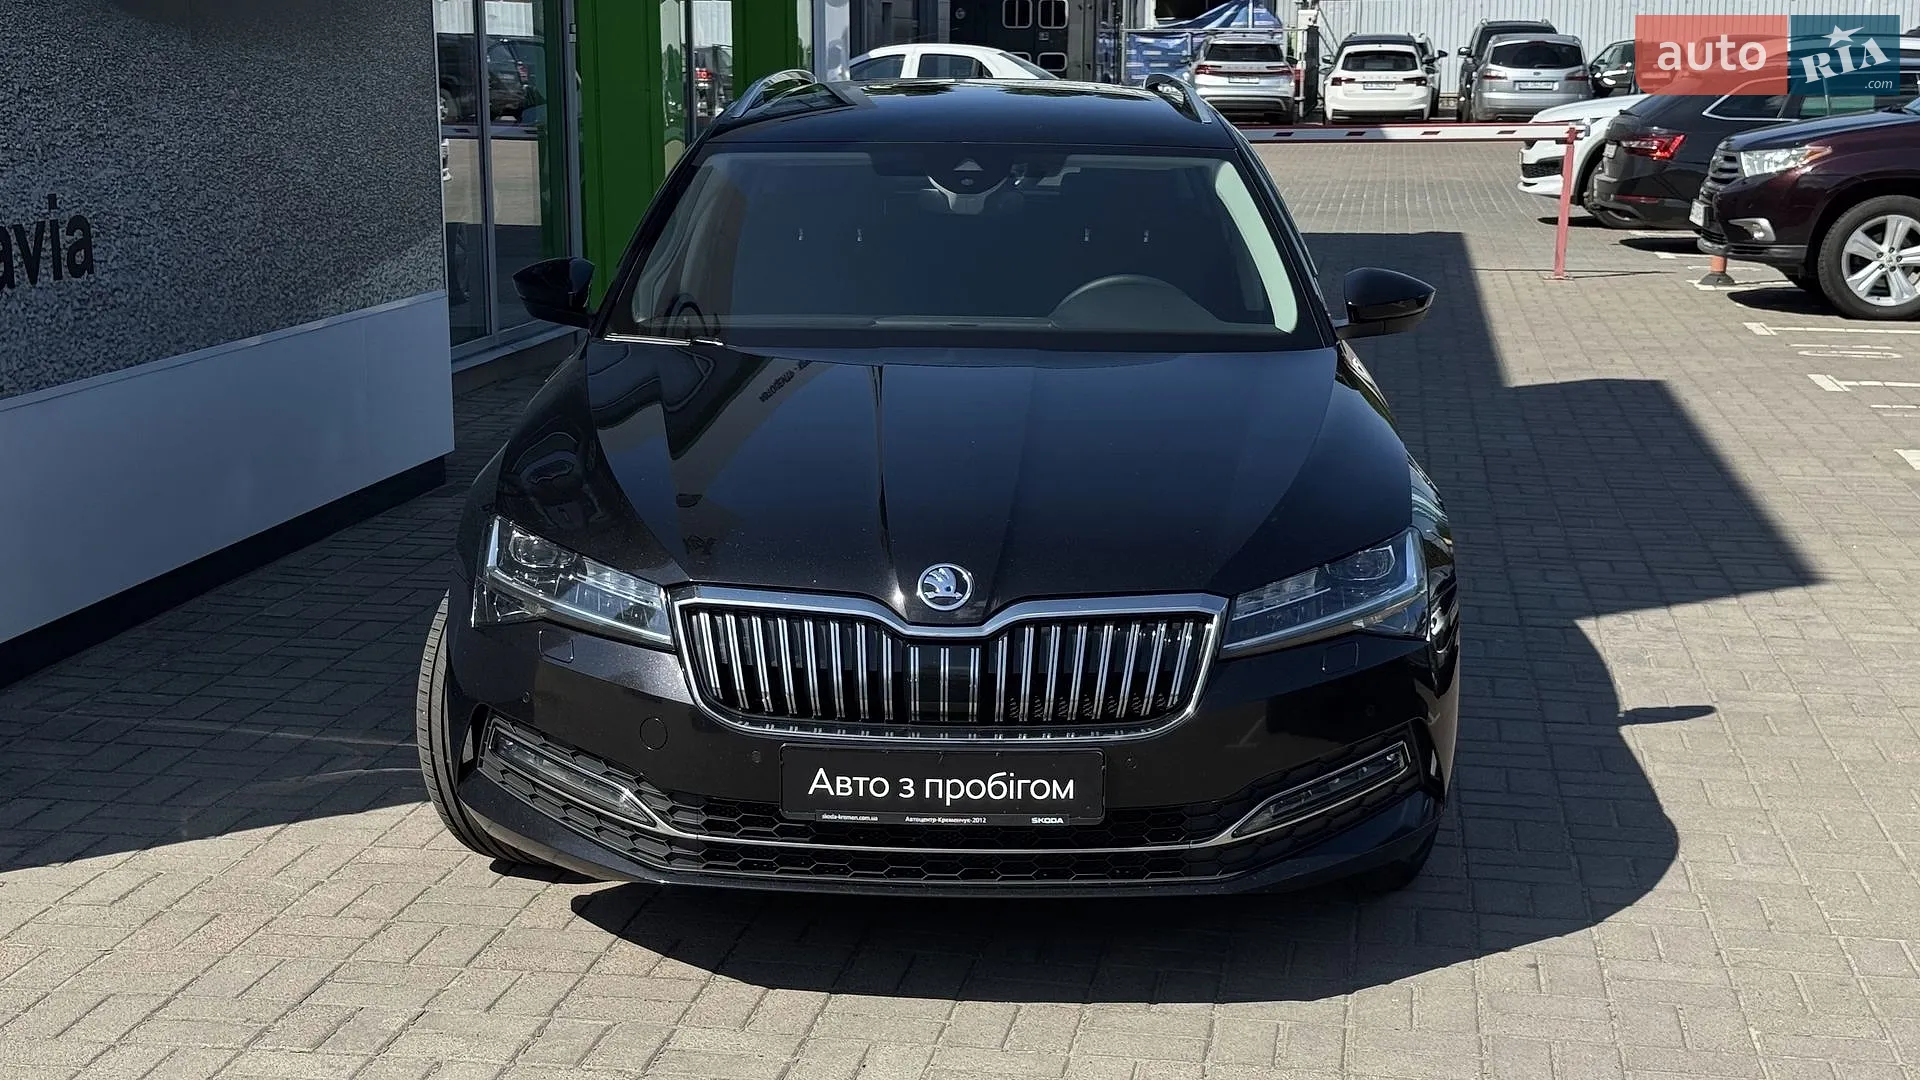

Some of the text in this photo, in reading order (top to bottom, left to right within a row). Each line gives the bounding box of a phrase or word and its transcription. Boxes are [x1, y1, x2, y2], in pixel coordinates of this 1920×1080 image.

[808, 768, 1074, 806] Авто з пробігом
